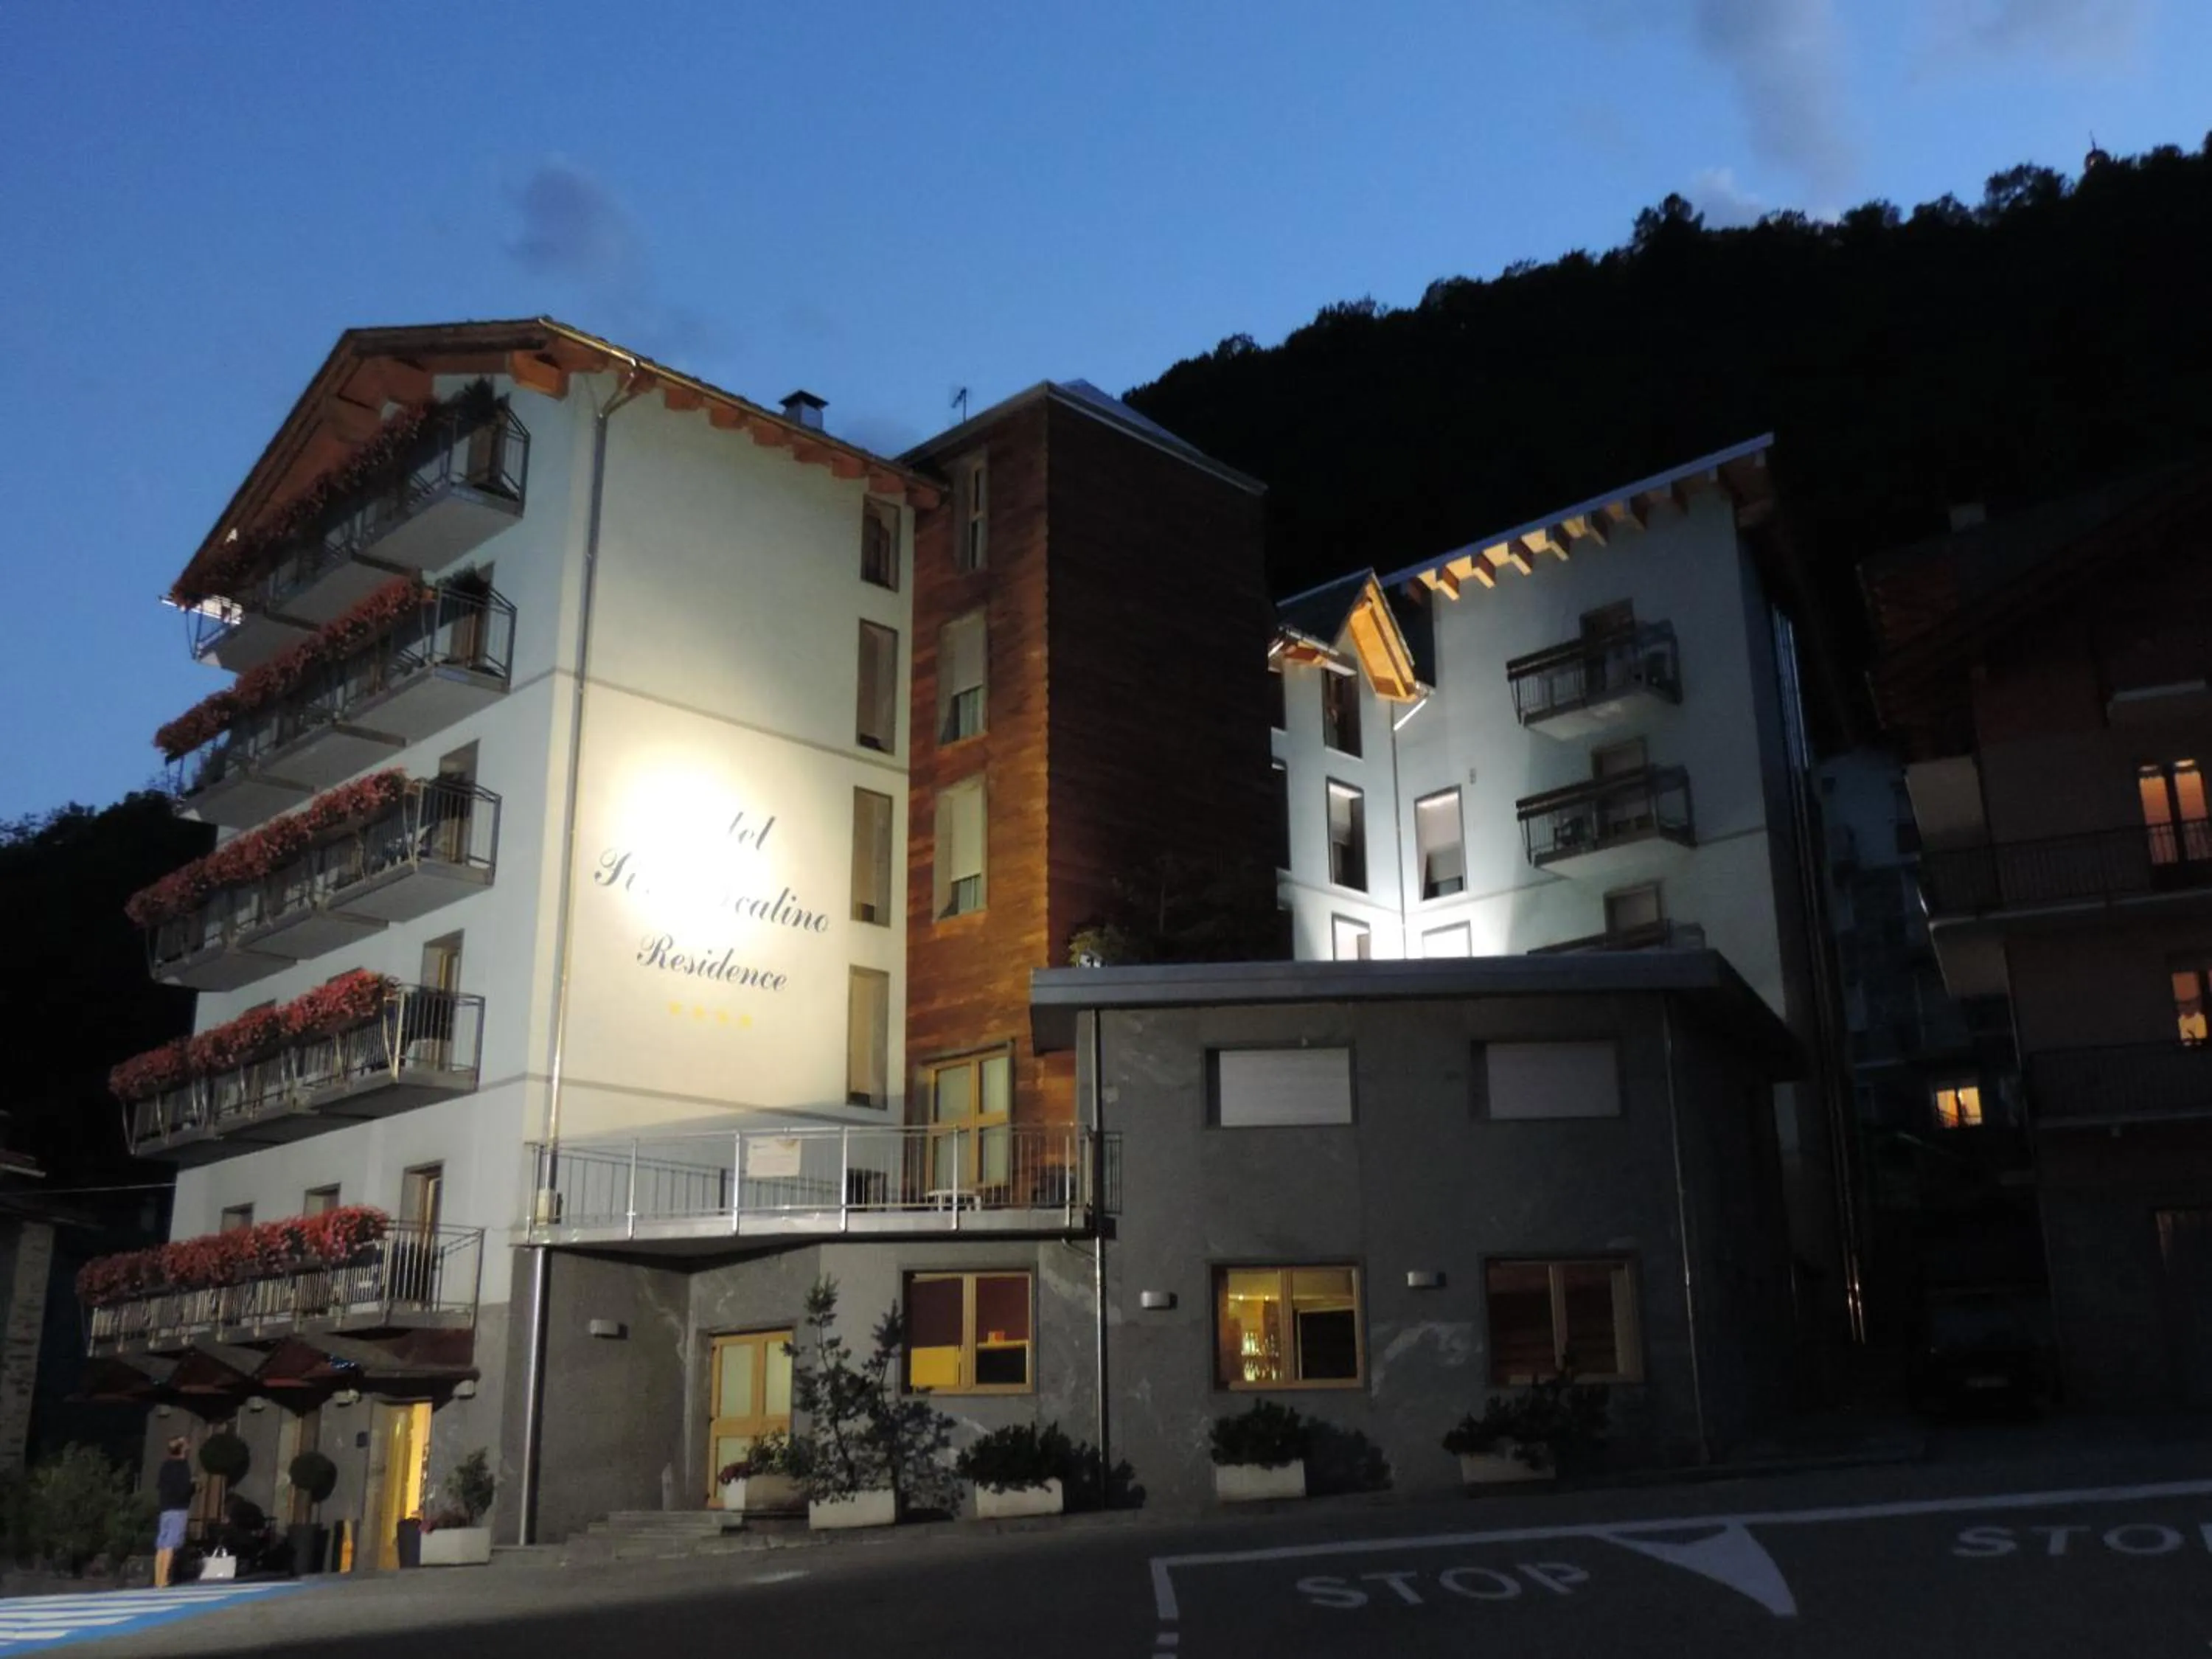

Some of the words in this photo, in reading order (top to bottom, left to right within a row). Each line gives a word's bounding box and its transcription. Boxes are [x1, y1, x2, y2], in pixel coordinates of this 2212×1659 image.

[721, 887, 830, 933] calino
[636, 933, 788, 992] Residence
[1952, 1523, 2212, 1557] STO
[1296, 1562, 1590, 1608] STOP
